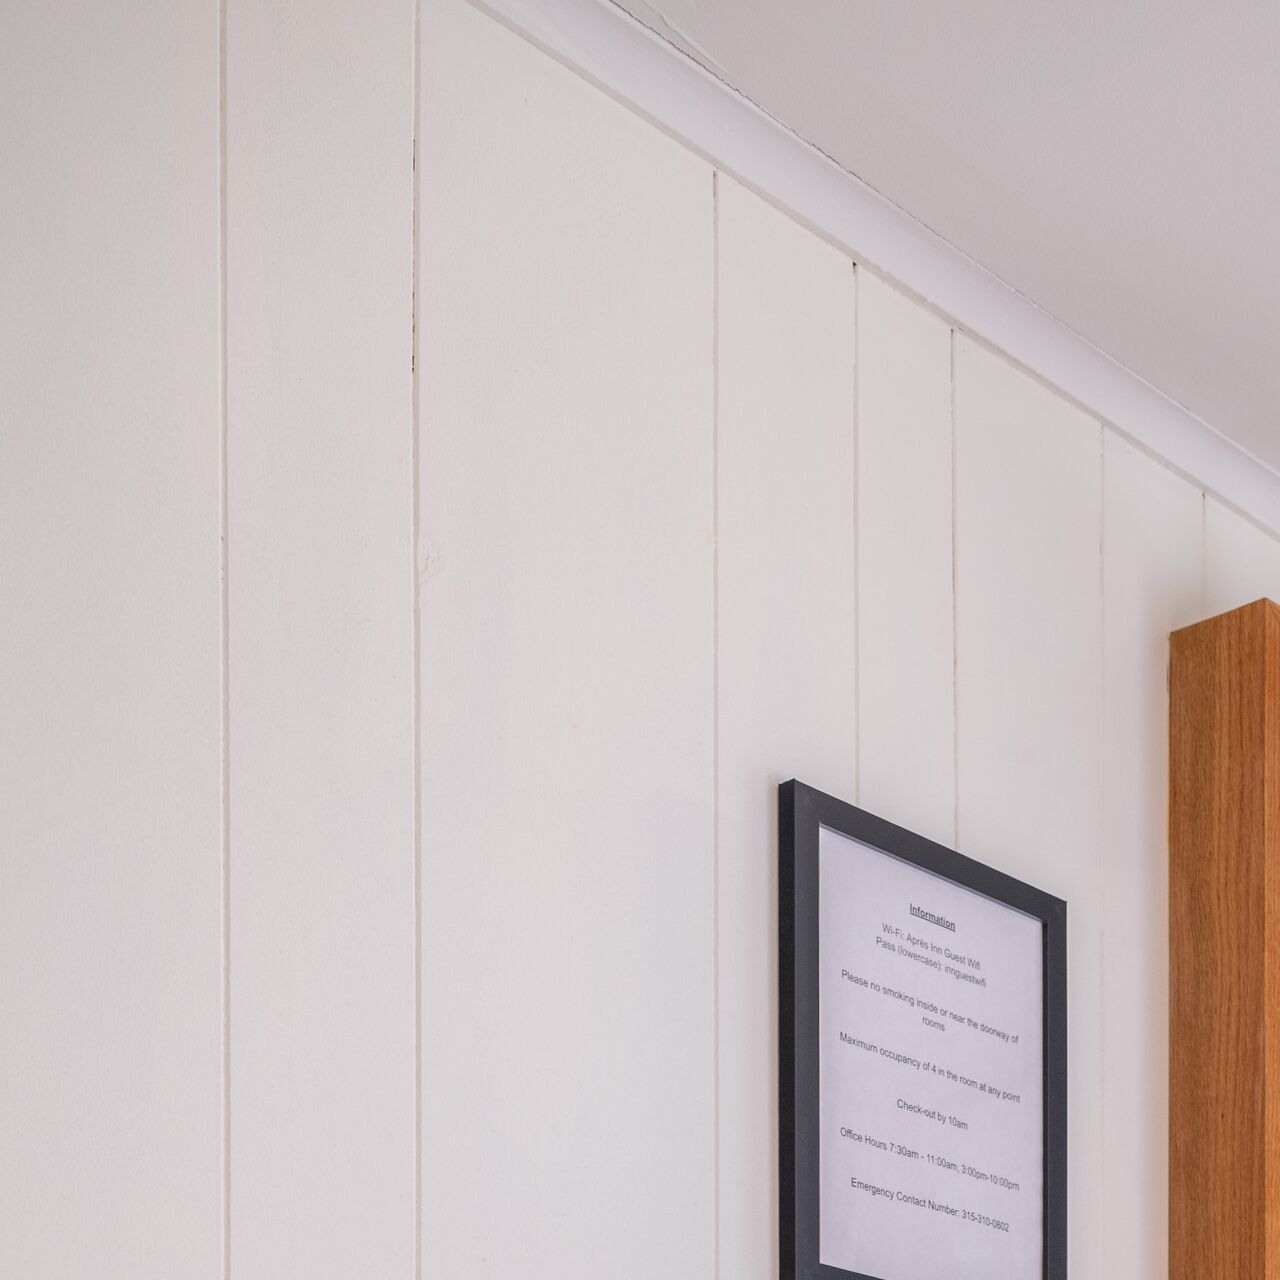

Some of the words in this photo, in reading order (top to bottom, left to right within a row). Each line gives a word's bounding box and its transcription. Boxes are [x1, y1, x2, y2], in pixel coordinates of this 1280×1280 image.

[909, 903, 956, 932] Information
[875, 936, 896, 952] Pass
[897, 944, 943, 972] (lowercase):
[944, 965, 987, 988] innguestwifi
[882, 922, 905, 940] Wi-Fi:
[906, 933, 929, 950] Après
[930, 942, 942, 955] Inn
[944, 948, 967, 965] Guest
[967, 956, 981, 971] Wifi
[841, 969, 869, 988] Please
[870, 981, 881, 992] no
[882, 986, 915, 1007] smoking
[916, 997, 939, 1014] inside
[939, 1006, 948, 1017] or
[949, 1011, 966, 1025] near
[966, 1015, 979, 1029] the
[979, 1021, 1010, 1043] doorway
[1010, 1034, 1019, 1044] of
[922, 1016, 946, 1032] rooms
[839, 1031, 878, 1054] Maximum
[879, 1047, 922, 1071] occupancy
[922, 1061, 931, 1071] of
[931, 1064, 937, 1074] 4
[937, 1066, 946, 1078] in
[946, 1070, 958, 1083] the
[959, 1075, 978, 1089] room
[978, 1081, 988, 1093] at
[987, 1085, 1001, 1098] any
[1002, 1090, 1021, 1103] point
[896, 1098, 936, 1120] Check-out
[937, 1111, 947, 1125] by
[948, 1115, 969, 1131] 10am
[840, 1126, 863, 1143] Office
[864, 1134, 888, 1151] Hours
[889, 1142, 919, 1160] 7:30am
[926, 1153, 960, 1173] 11:00am,
[961, 1164, 1020, 1191] 3:00pm-10:00pm
[851, 1177, 895, 1201] Emergency
[896, 1191, 927, 1208] Contact
[928, 1199, 959, 1217] Number:
[961, 1210, 1010, 1233] 315-310-0802
